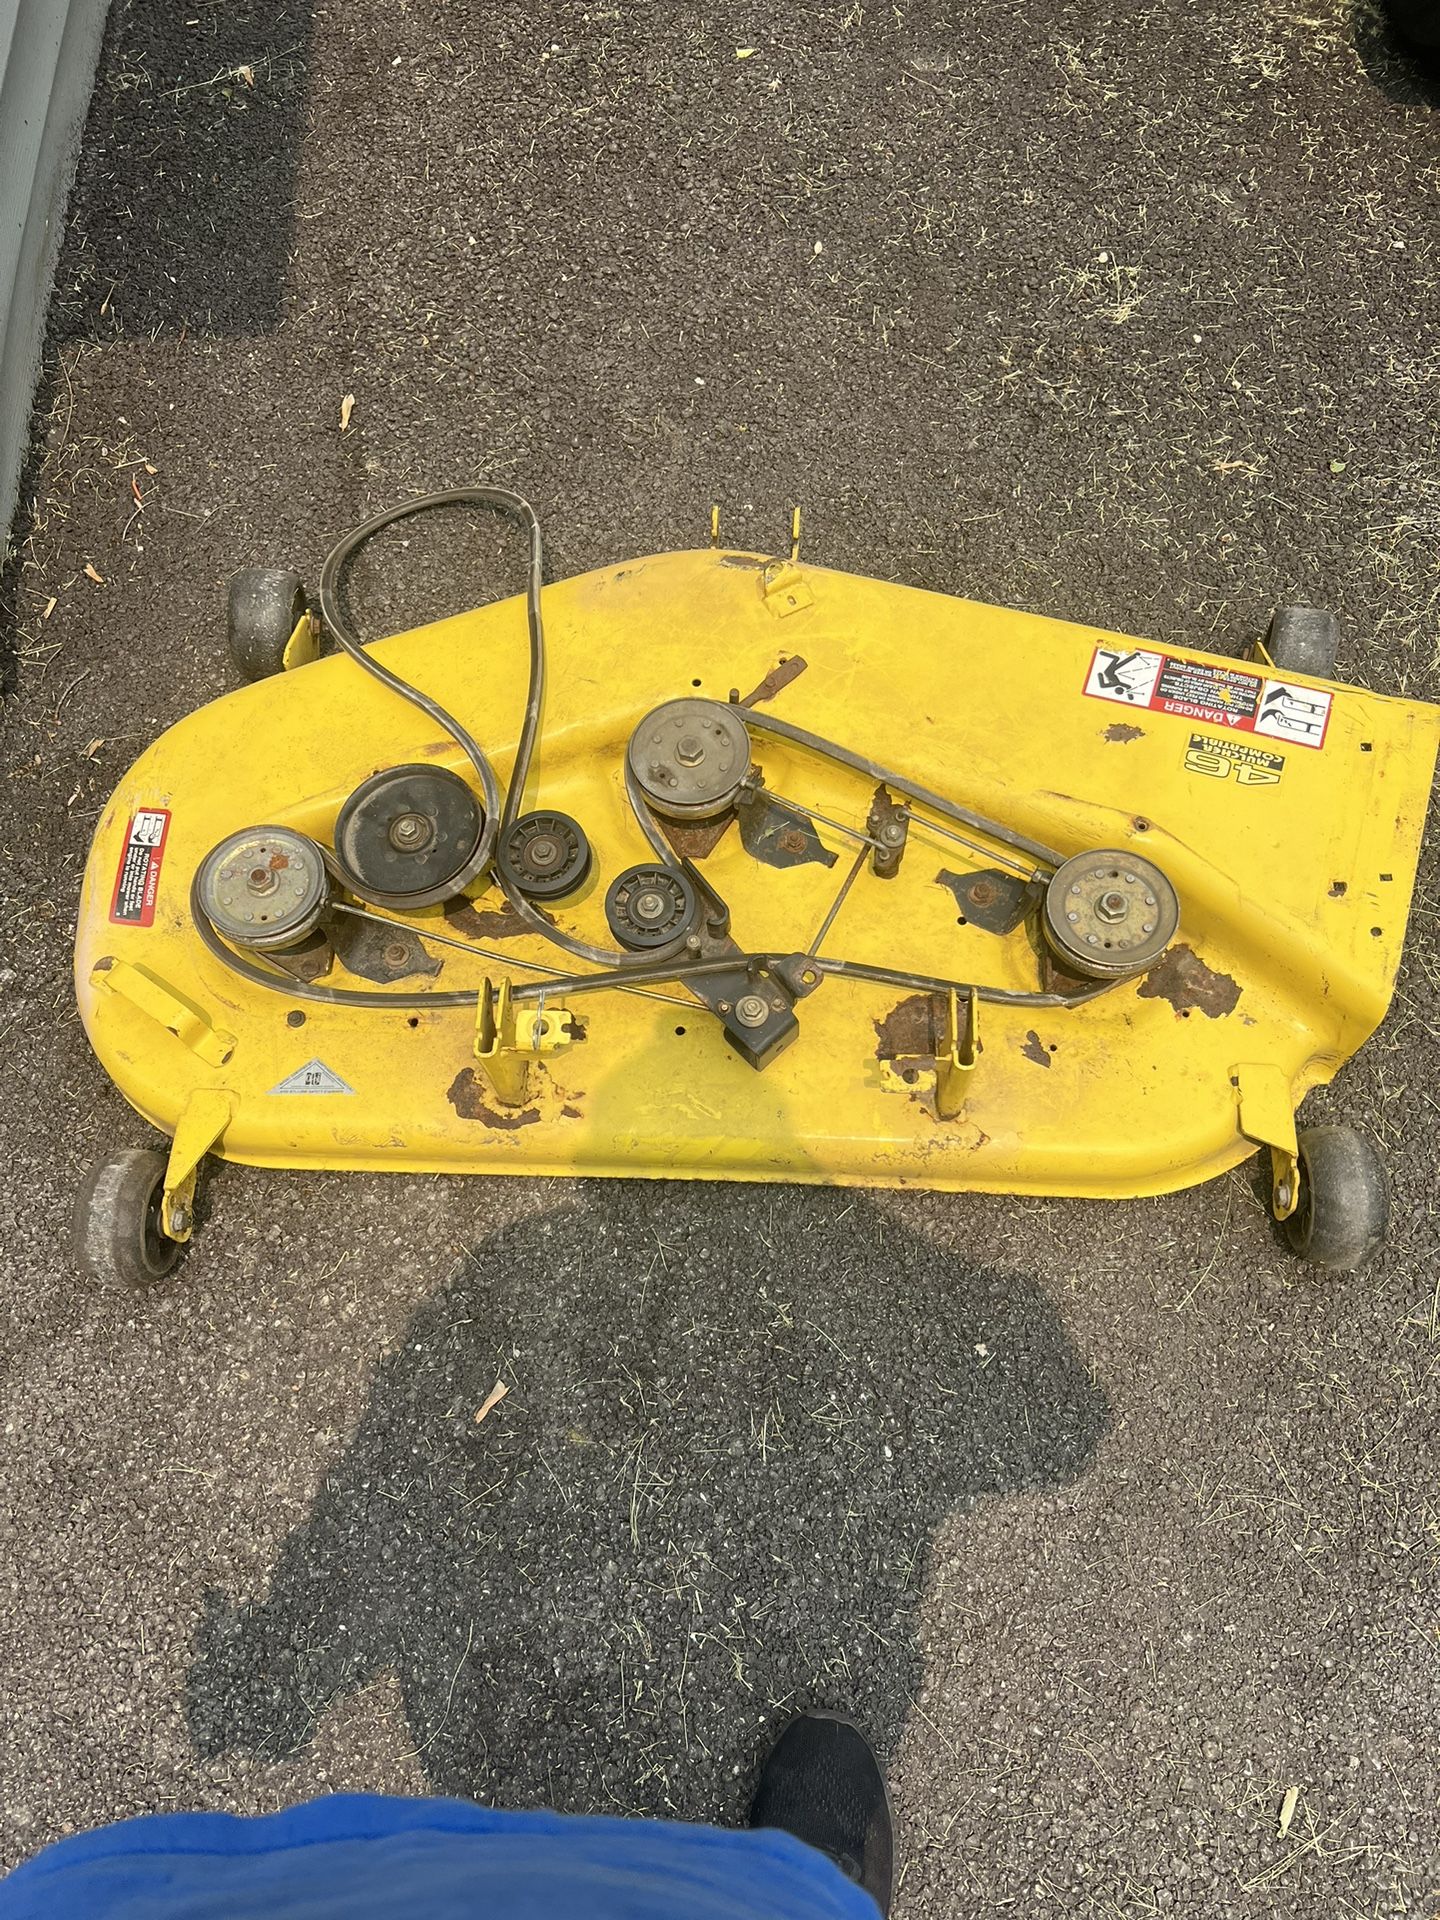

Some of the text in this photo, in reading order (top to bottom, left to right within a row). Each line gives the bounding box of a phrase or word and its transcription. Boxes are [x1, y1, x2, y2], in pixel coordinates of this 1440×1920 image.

[1174, 681, 1209, 693] OBJECTS
[1173, 694, 1199, 704] BLADE
[1200, 700, 1238, 713] ROTATING
[1164, 701, 1223, 723] DANGER
[1193, 734, 1283, 763] COMPATIBLE
[1202, 744, 1269, 767] MULCHER
[1184, 750, 1281, 785] 46
[139, 848, 145, 856] Do
[134, 853, 150, 908] ROTATING BLADE
[146, 871, 157, 906] DANGER
